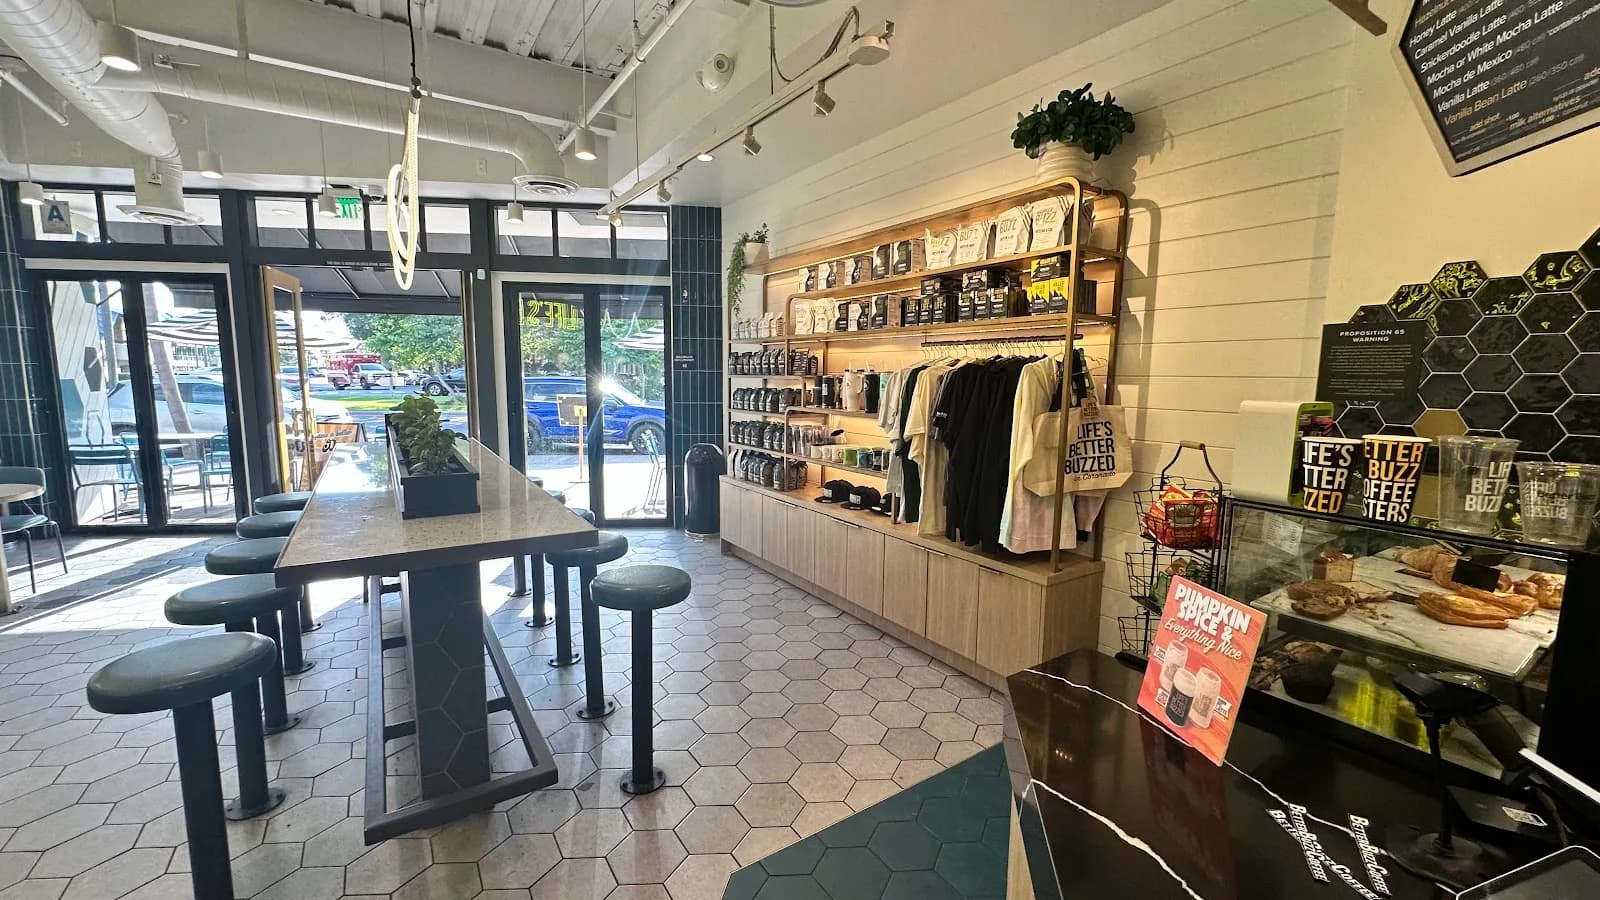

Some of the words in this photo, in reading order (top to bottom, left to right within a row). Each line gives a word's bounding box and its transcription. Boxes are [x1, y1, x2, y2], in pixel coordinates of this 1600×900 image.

[1409, 25, 1435, 47] Honey
[1436, 10, 1457, 30] Latte
[1415, 31, 1448, 60] Caramel
[1449, 13, 1478, 37] Vanilla
[1480, 0, 1504, 18] Latte
[1421, 31, 1481, 73] Snickerdoodle
[1482, 15, 1507, 36] Latte
[1427, 64, 1455, 86] Mocha
[1456, 56, 1467, 69] or
[1467, 41, 1494, 62] White
[1496, 19, 1532, 46] Mocha
[1534, 1, 1564, 24] Latte
[1433, 77, 1462, 99] Mocha
[1463, 70, 1476, 82] de
[1477, 49, 1513, 75] Mexico
[1437, 93, 1465, 113] Vanilla
[1466, 80, 1490, 99] Latte
[1444, 106, 1473, 126] Vanilla
[1474, 94, 1499, 112] Bean
[1501, 80, 1527, 99] Latte
[1528, 95, 1582, 123] alternatives
[1469, 120, 1483, 132] add
[1484, 112, 1500, 125] shot
[48, 204, 65, 221] A
[1077, 421, 1113, 440] LIFE'S
[1069, 438, 1115, 458] BETTER
[1303, 441, 1355, 467] IFE'S
[1364, 438, 1425, 463] ETTER
[1064, 455, 1116, 475] BUZZED
[1368, 459, 1420, 483] BUZZ
[1363, 478, 1415, 503] OFFEE
[1362, 498, 1410, 523] STERS
[1174, 583, 1252, 634] PUMPKIN
[1177, 602, 1219, 637] SPICE
[1221, 625, 1233, 643] &
[1164, 617, 1216, 656] Everything
[1216, 640, 1243, 660] Nice
